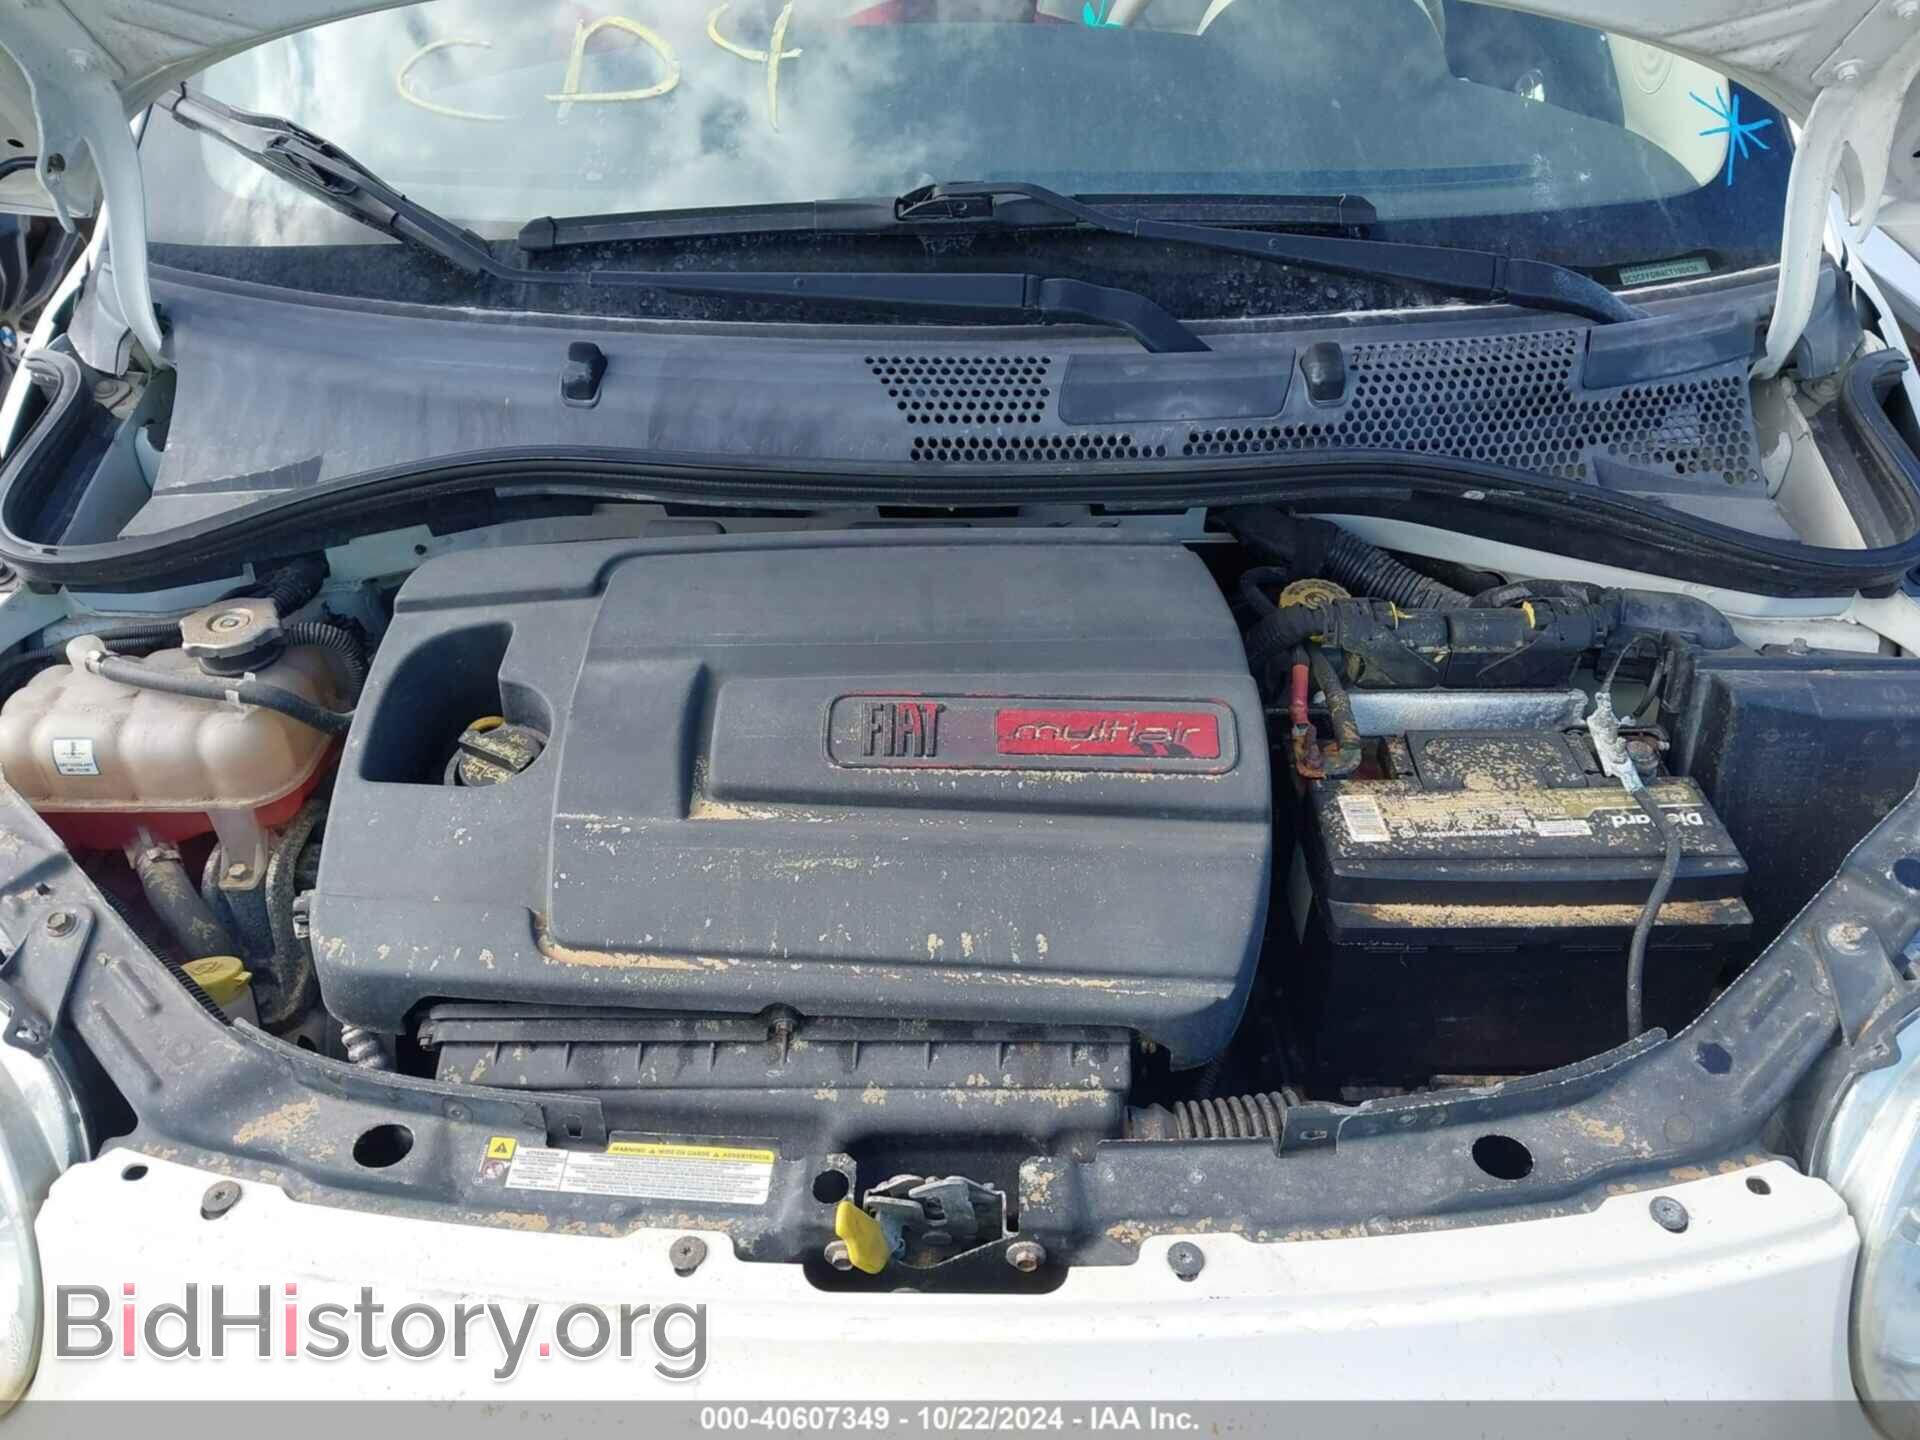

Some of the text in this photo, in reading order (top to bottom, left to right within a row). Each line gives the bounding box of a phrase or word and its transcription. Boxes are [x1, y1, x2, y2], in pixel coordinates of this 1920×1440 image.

[862, 702, 1201, 758] FIAT multiair
[1611, 811, 1704, 829] Dieard
